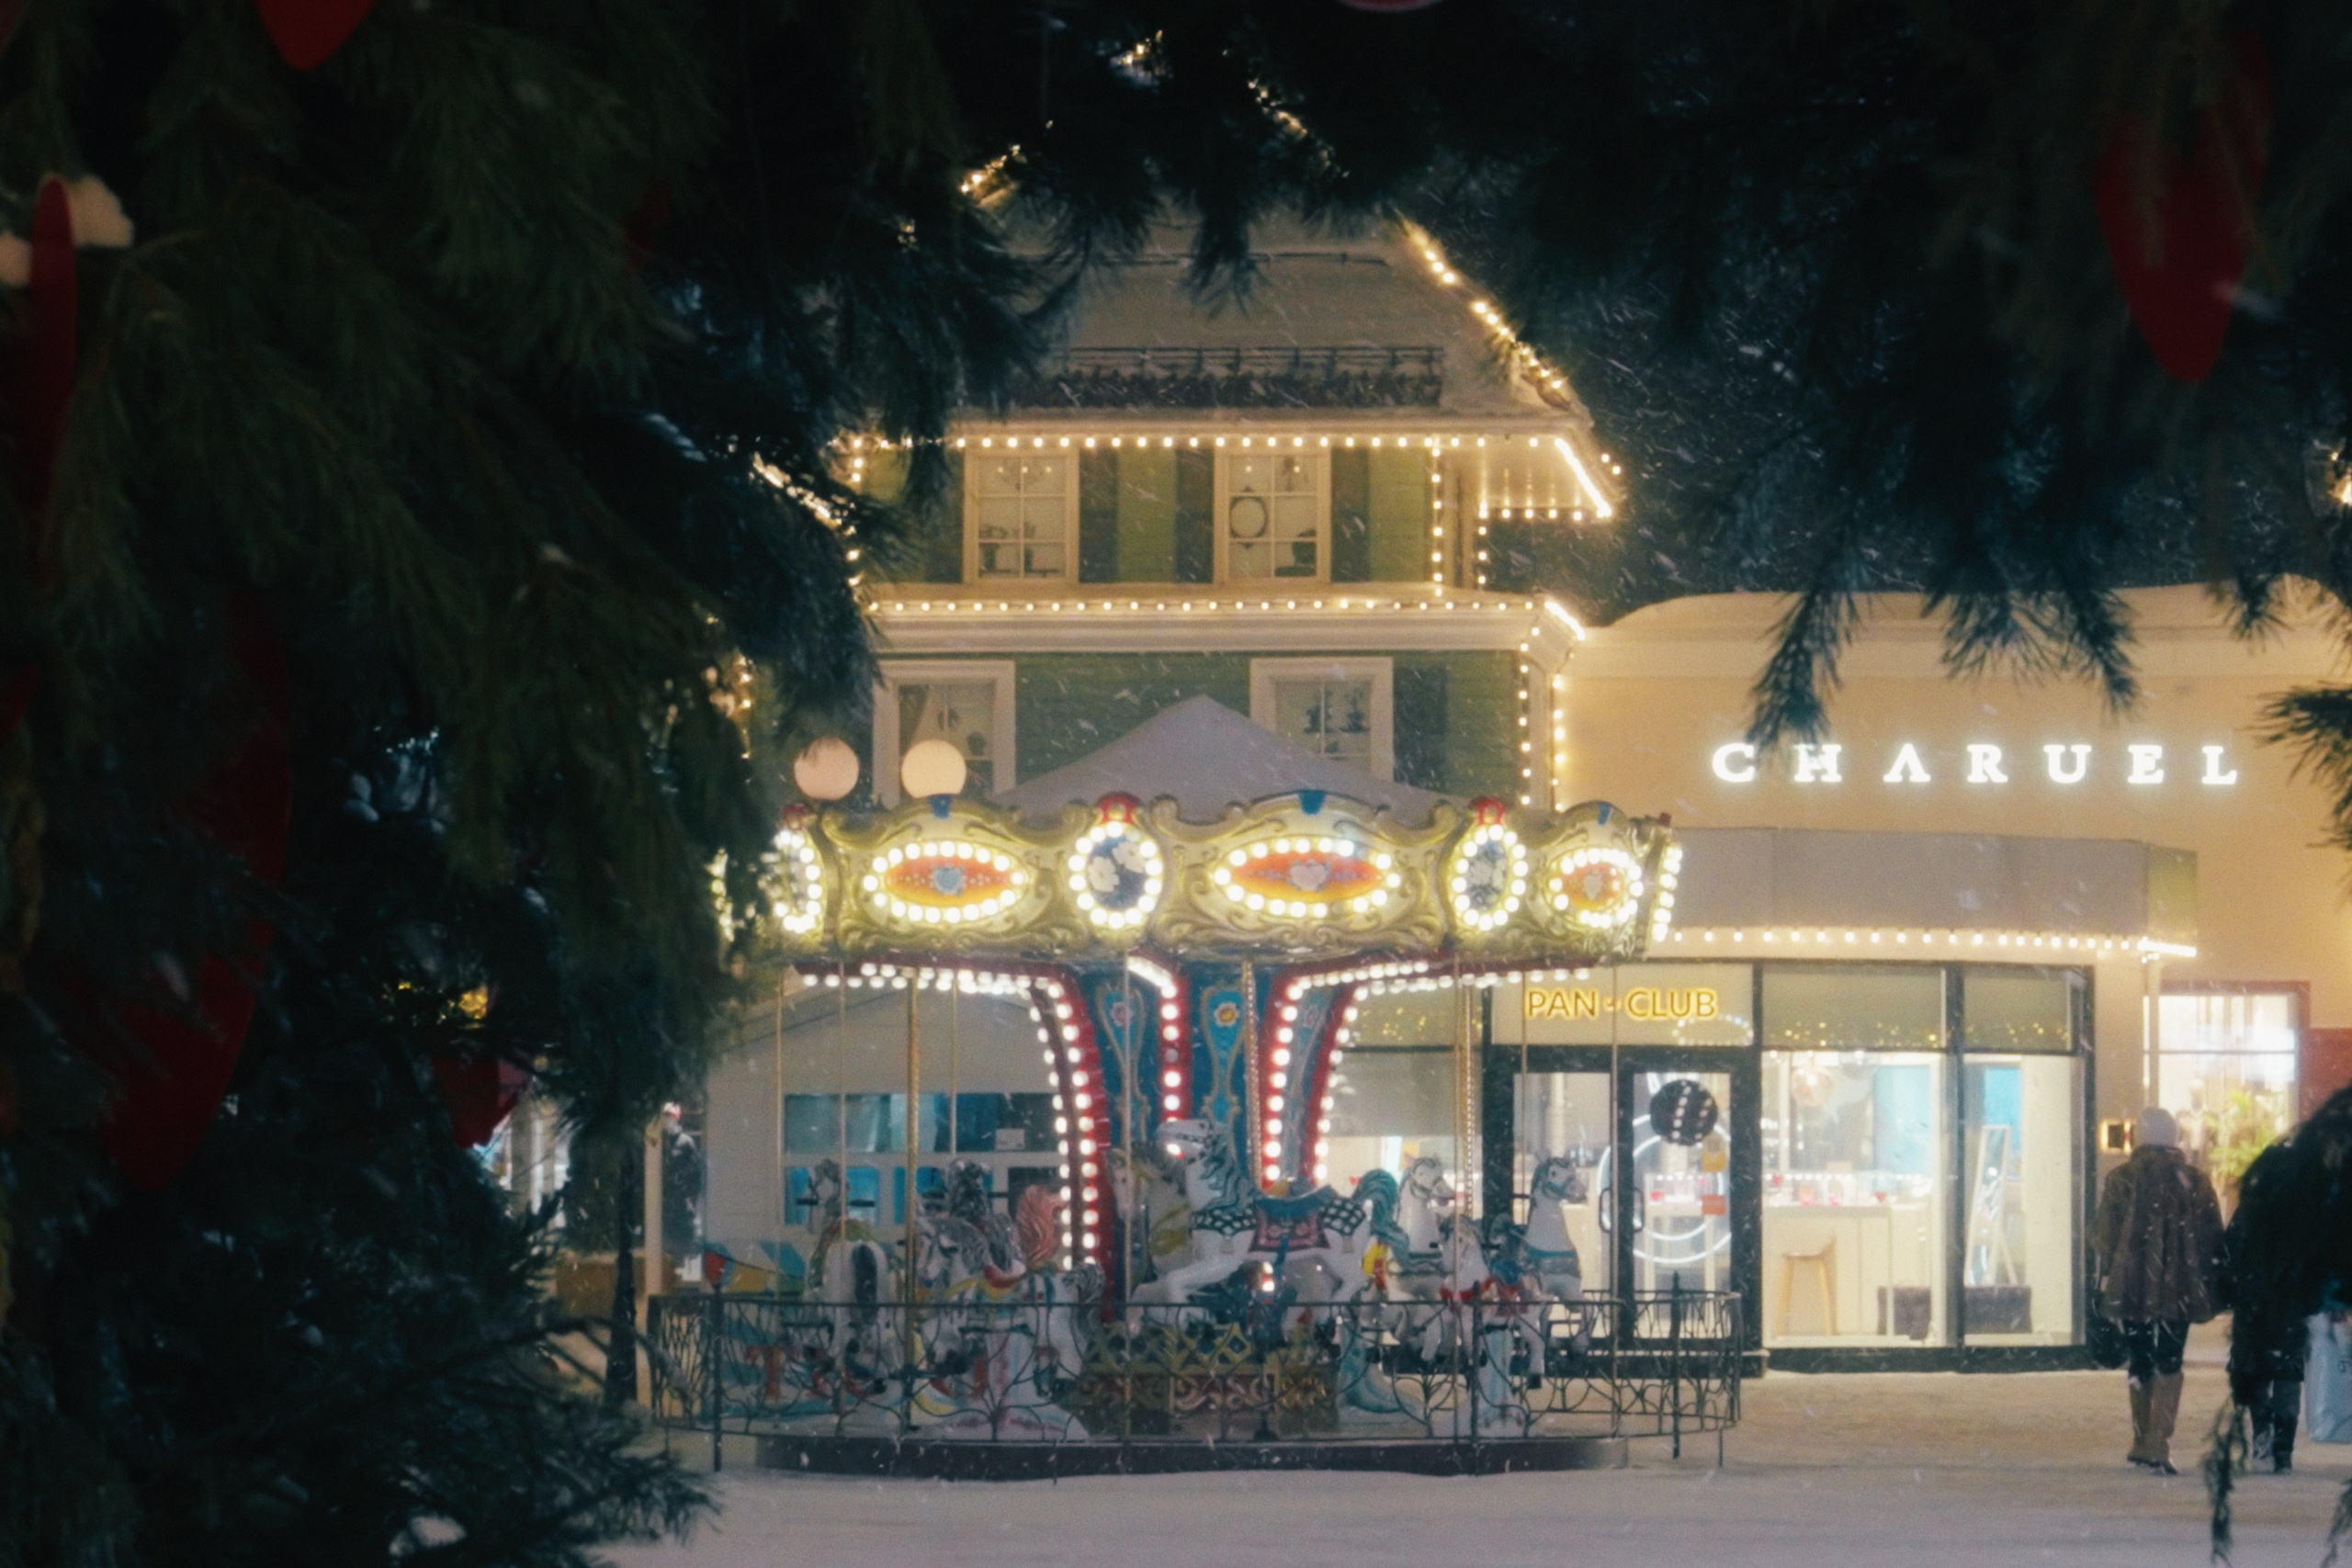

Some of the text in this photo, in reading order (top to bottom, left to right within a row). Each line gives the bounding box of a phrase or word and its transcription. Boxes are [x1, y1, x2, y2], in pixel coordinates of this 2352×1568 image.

[1712, 743, 2238, 784] CHARUEL
[1526, 988, 1718, 1020] PAN CLUB
